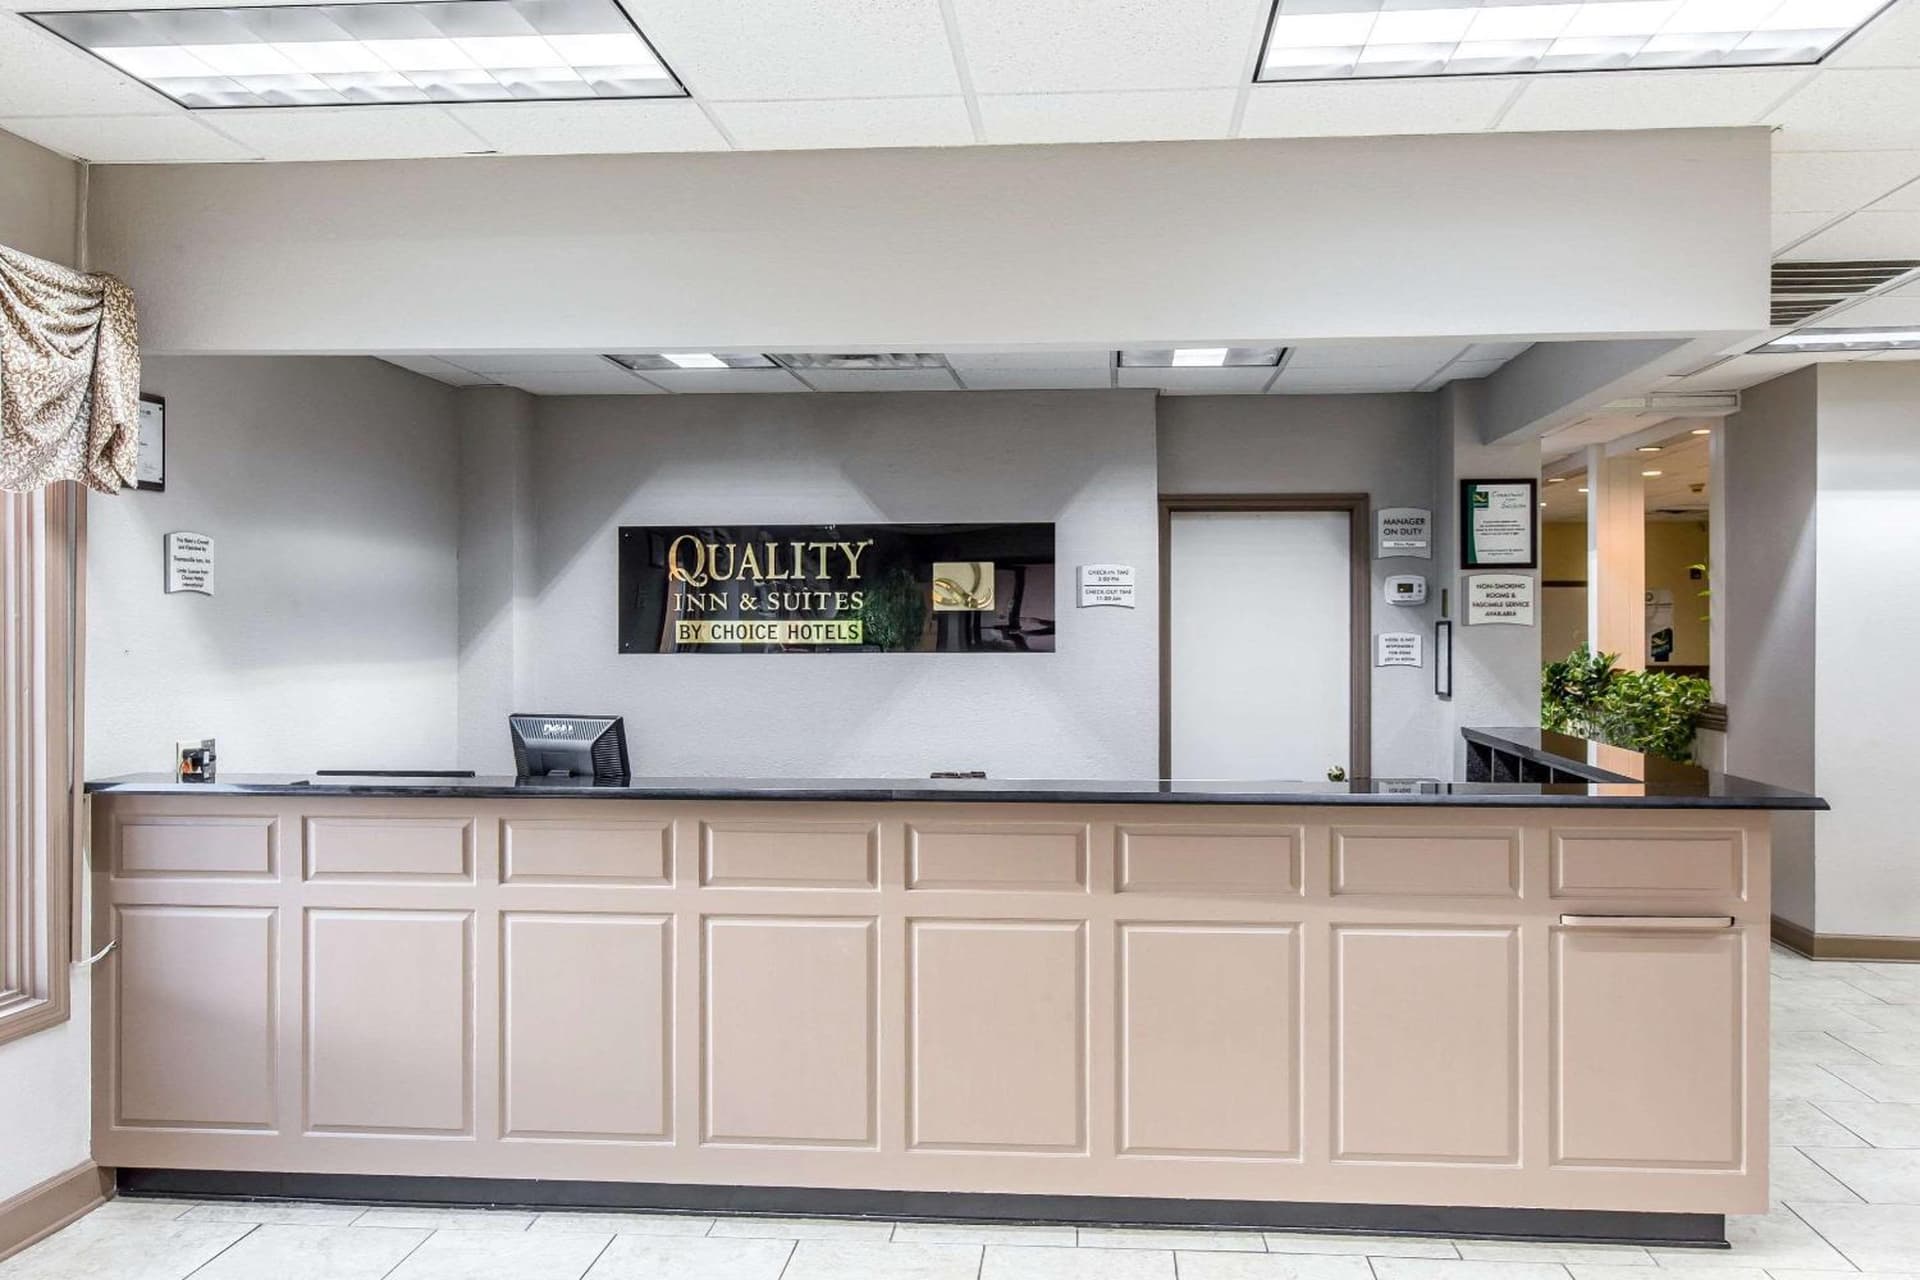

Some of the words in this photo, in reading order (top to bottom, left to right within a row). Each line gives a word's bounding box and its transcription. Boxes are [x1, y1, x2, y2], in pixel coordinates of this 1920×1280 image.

[1383, 517, 1425, 526] MANAGER
[1383, 527, 1399, 536] ON
[1400, 527, 1423, 536] DUTY
[668, 534, 869, 587] QUALITY
[673, 592, 728, 613] INN
[740, 592, 759, 612] &
[767, 591, 864, 612] SUITES
[678, 622, 704, 641] BY
[711, 622, 777, 641] CHOICE
[787, 622, 860, 641] HOTELS
